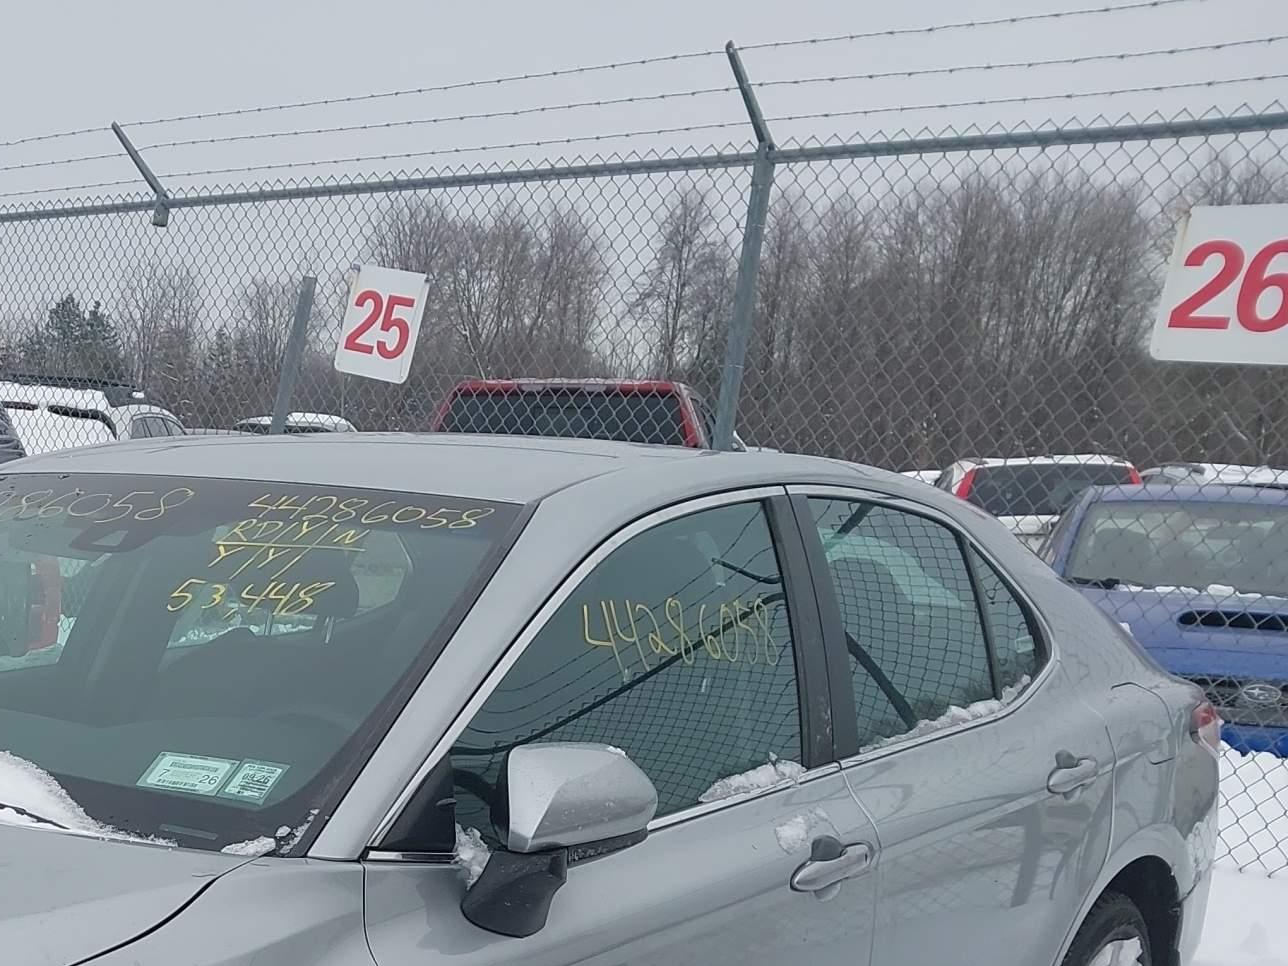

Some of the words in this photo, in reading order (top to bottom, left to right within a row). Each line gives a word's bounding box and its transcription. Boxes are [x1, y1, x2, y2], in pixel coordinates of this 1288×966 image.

[1168, 239, 1288, 333] 26
[343, 289, 416, 360] 25
[248, 494, 495, 530] 44286058
[167, 578, 336, 620] 53,448
[584, 598, 778, 672] 44286058
[198, 774, 220, 786] 26
